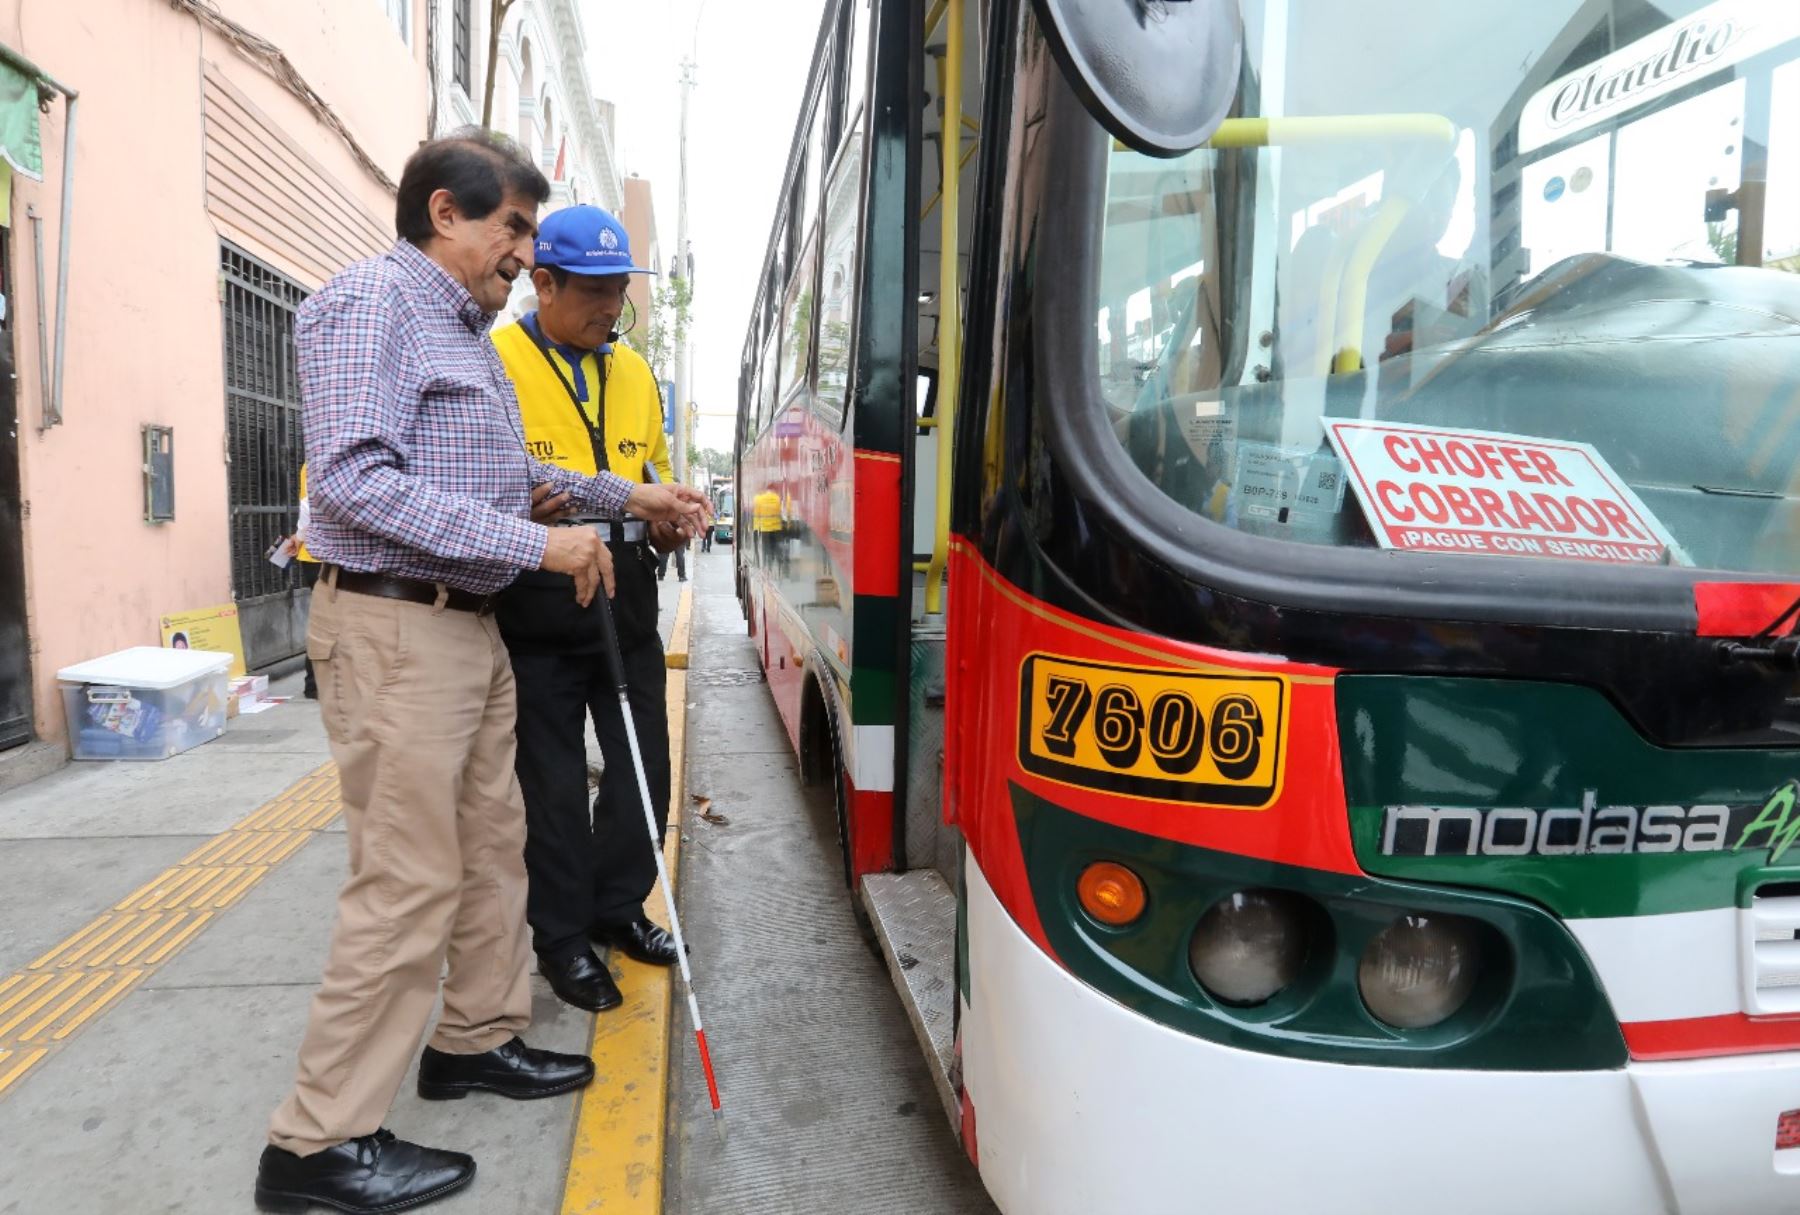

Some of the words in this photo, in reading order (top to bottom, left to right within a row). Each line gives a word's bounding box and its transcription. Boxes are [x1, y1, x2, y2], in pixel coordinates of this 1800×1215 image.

[1549, 20, 1736, 124] Claudio
[1383, 435, 1575, 487] CHOFER
[1375, 480, 1648, 540] COBRADOR
[1491, 535, 1543, 554] CON
[1549, 541, 1662, 563] SENCILLO!
[1042, 674, 1264, 780] 7606
[1382, 788, 1730, 855] modasa
